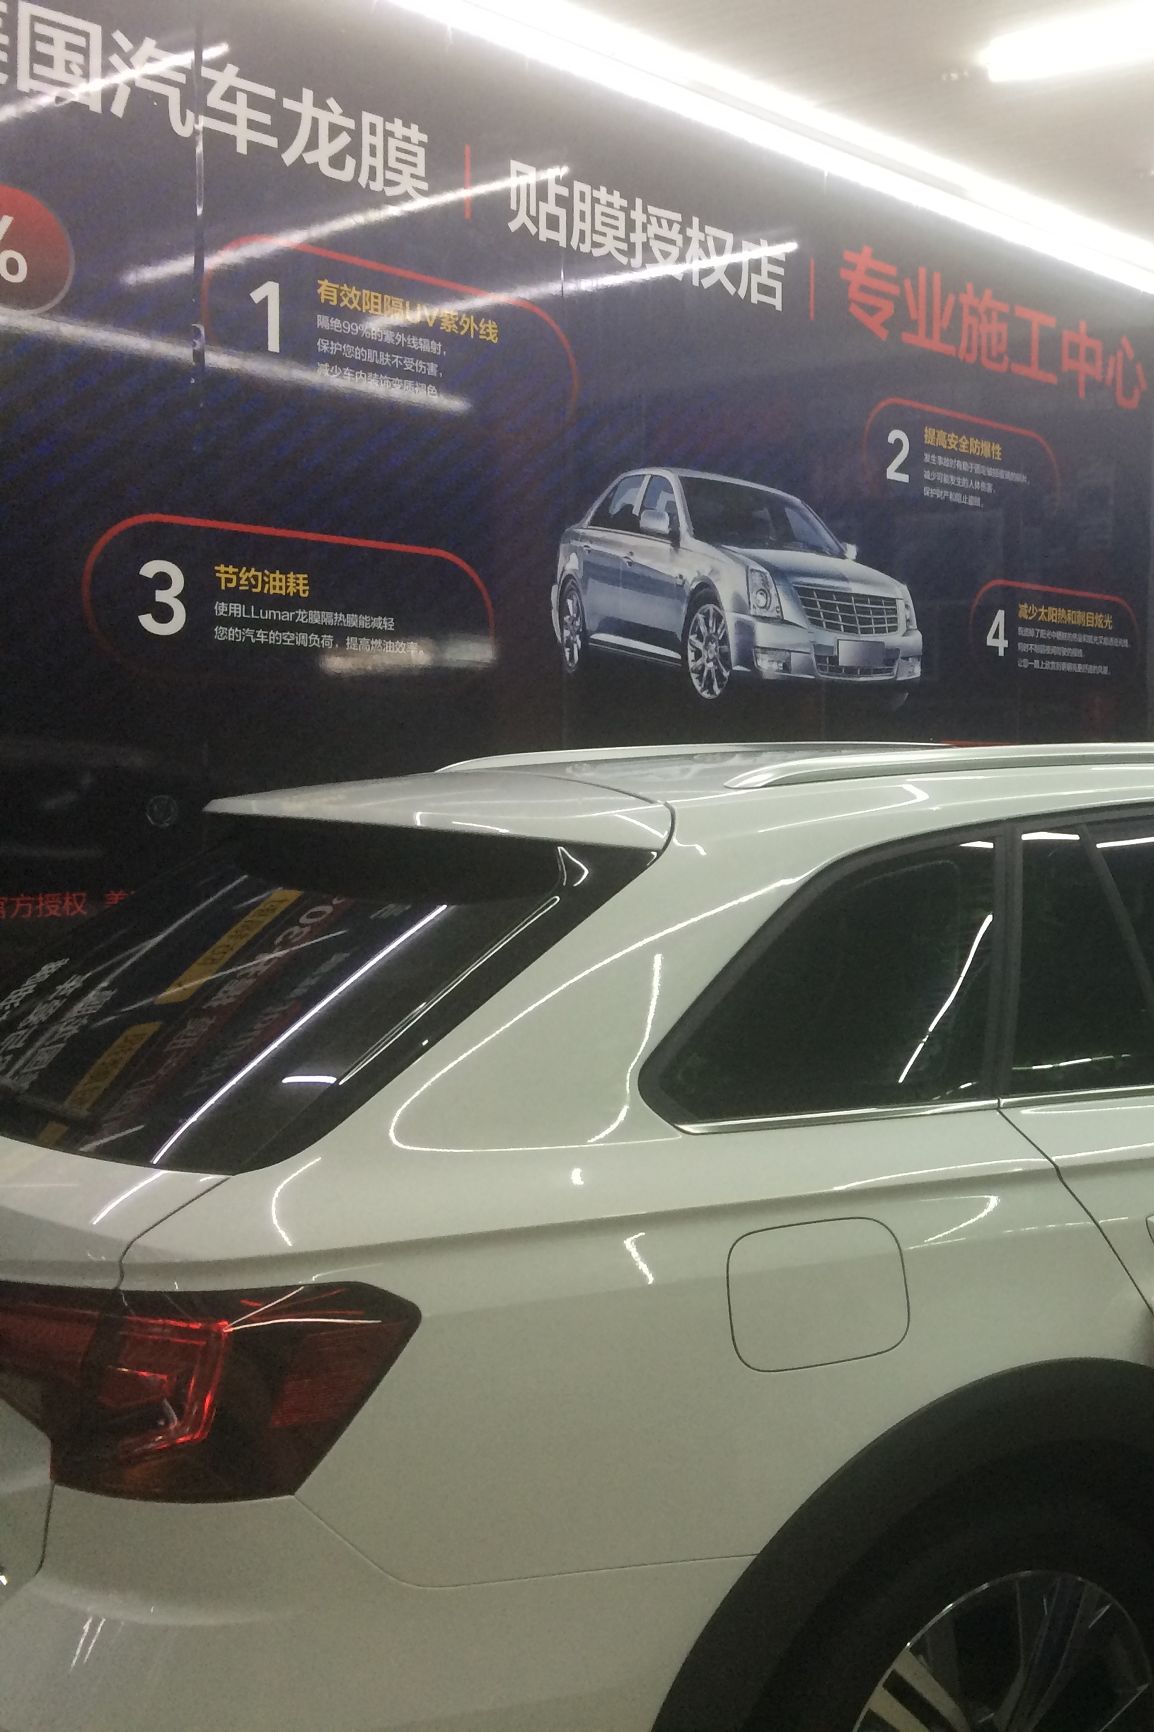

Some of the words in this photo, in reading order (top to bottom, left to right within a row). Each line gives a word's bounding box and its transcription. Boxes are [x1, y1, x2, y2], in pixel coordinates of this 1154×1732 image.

[0, 1, 429, 200] 国汽车龙膜
[508, 158, 786, 311] 贴膜授权店
[839, 246, 1148, 410] 专业施工中心
[249, 281, 281, 353] 1
[317, 279, 499, 343] 有效阻隔UV紫外线
[886, 429, 910, 483] 2
[924, 425, 1002, 461] 提高安全防爆性
[137, 560, 187, 636] 3
[214, 563, 310, 598] 节约油耗
[214, 600, 396, 631] 使用LLumar龙膜隔热膜能减轻
[986, 609, 1009, 656] 4
[0, 892, 88, 919] 方授权
